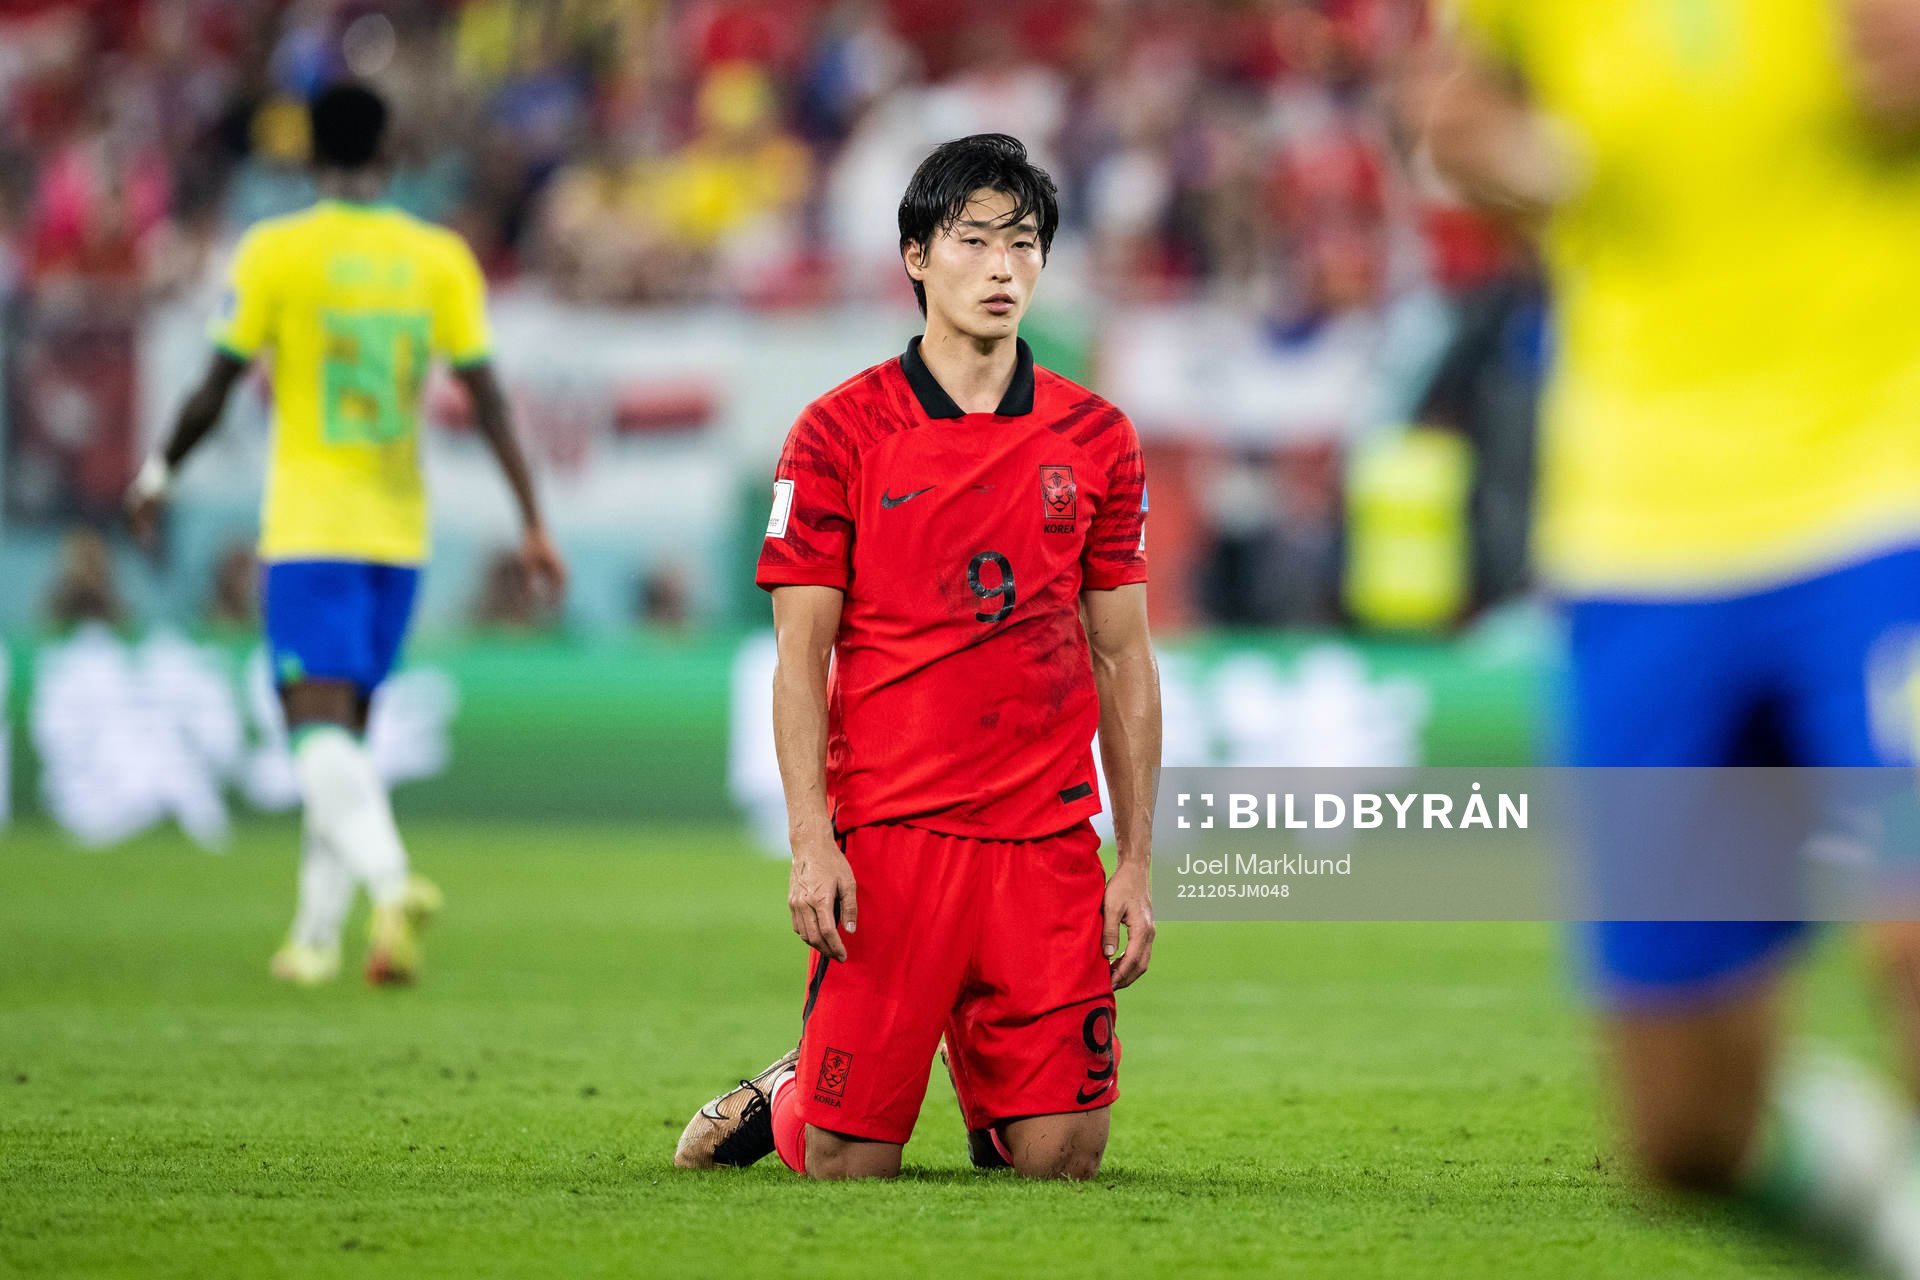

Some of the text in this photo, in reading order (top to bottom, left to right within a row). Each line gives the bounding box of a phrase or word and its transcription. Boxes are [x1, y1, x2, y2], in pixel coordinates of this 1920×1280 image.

[1043, 524, 1075, 534] KOREA
[967, 551, 1016, 623] 9
[1082, 1006, 1114, 1081] 9
[813, 1092, 842, 1108] KOREA
